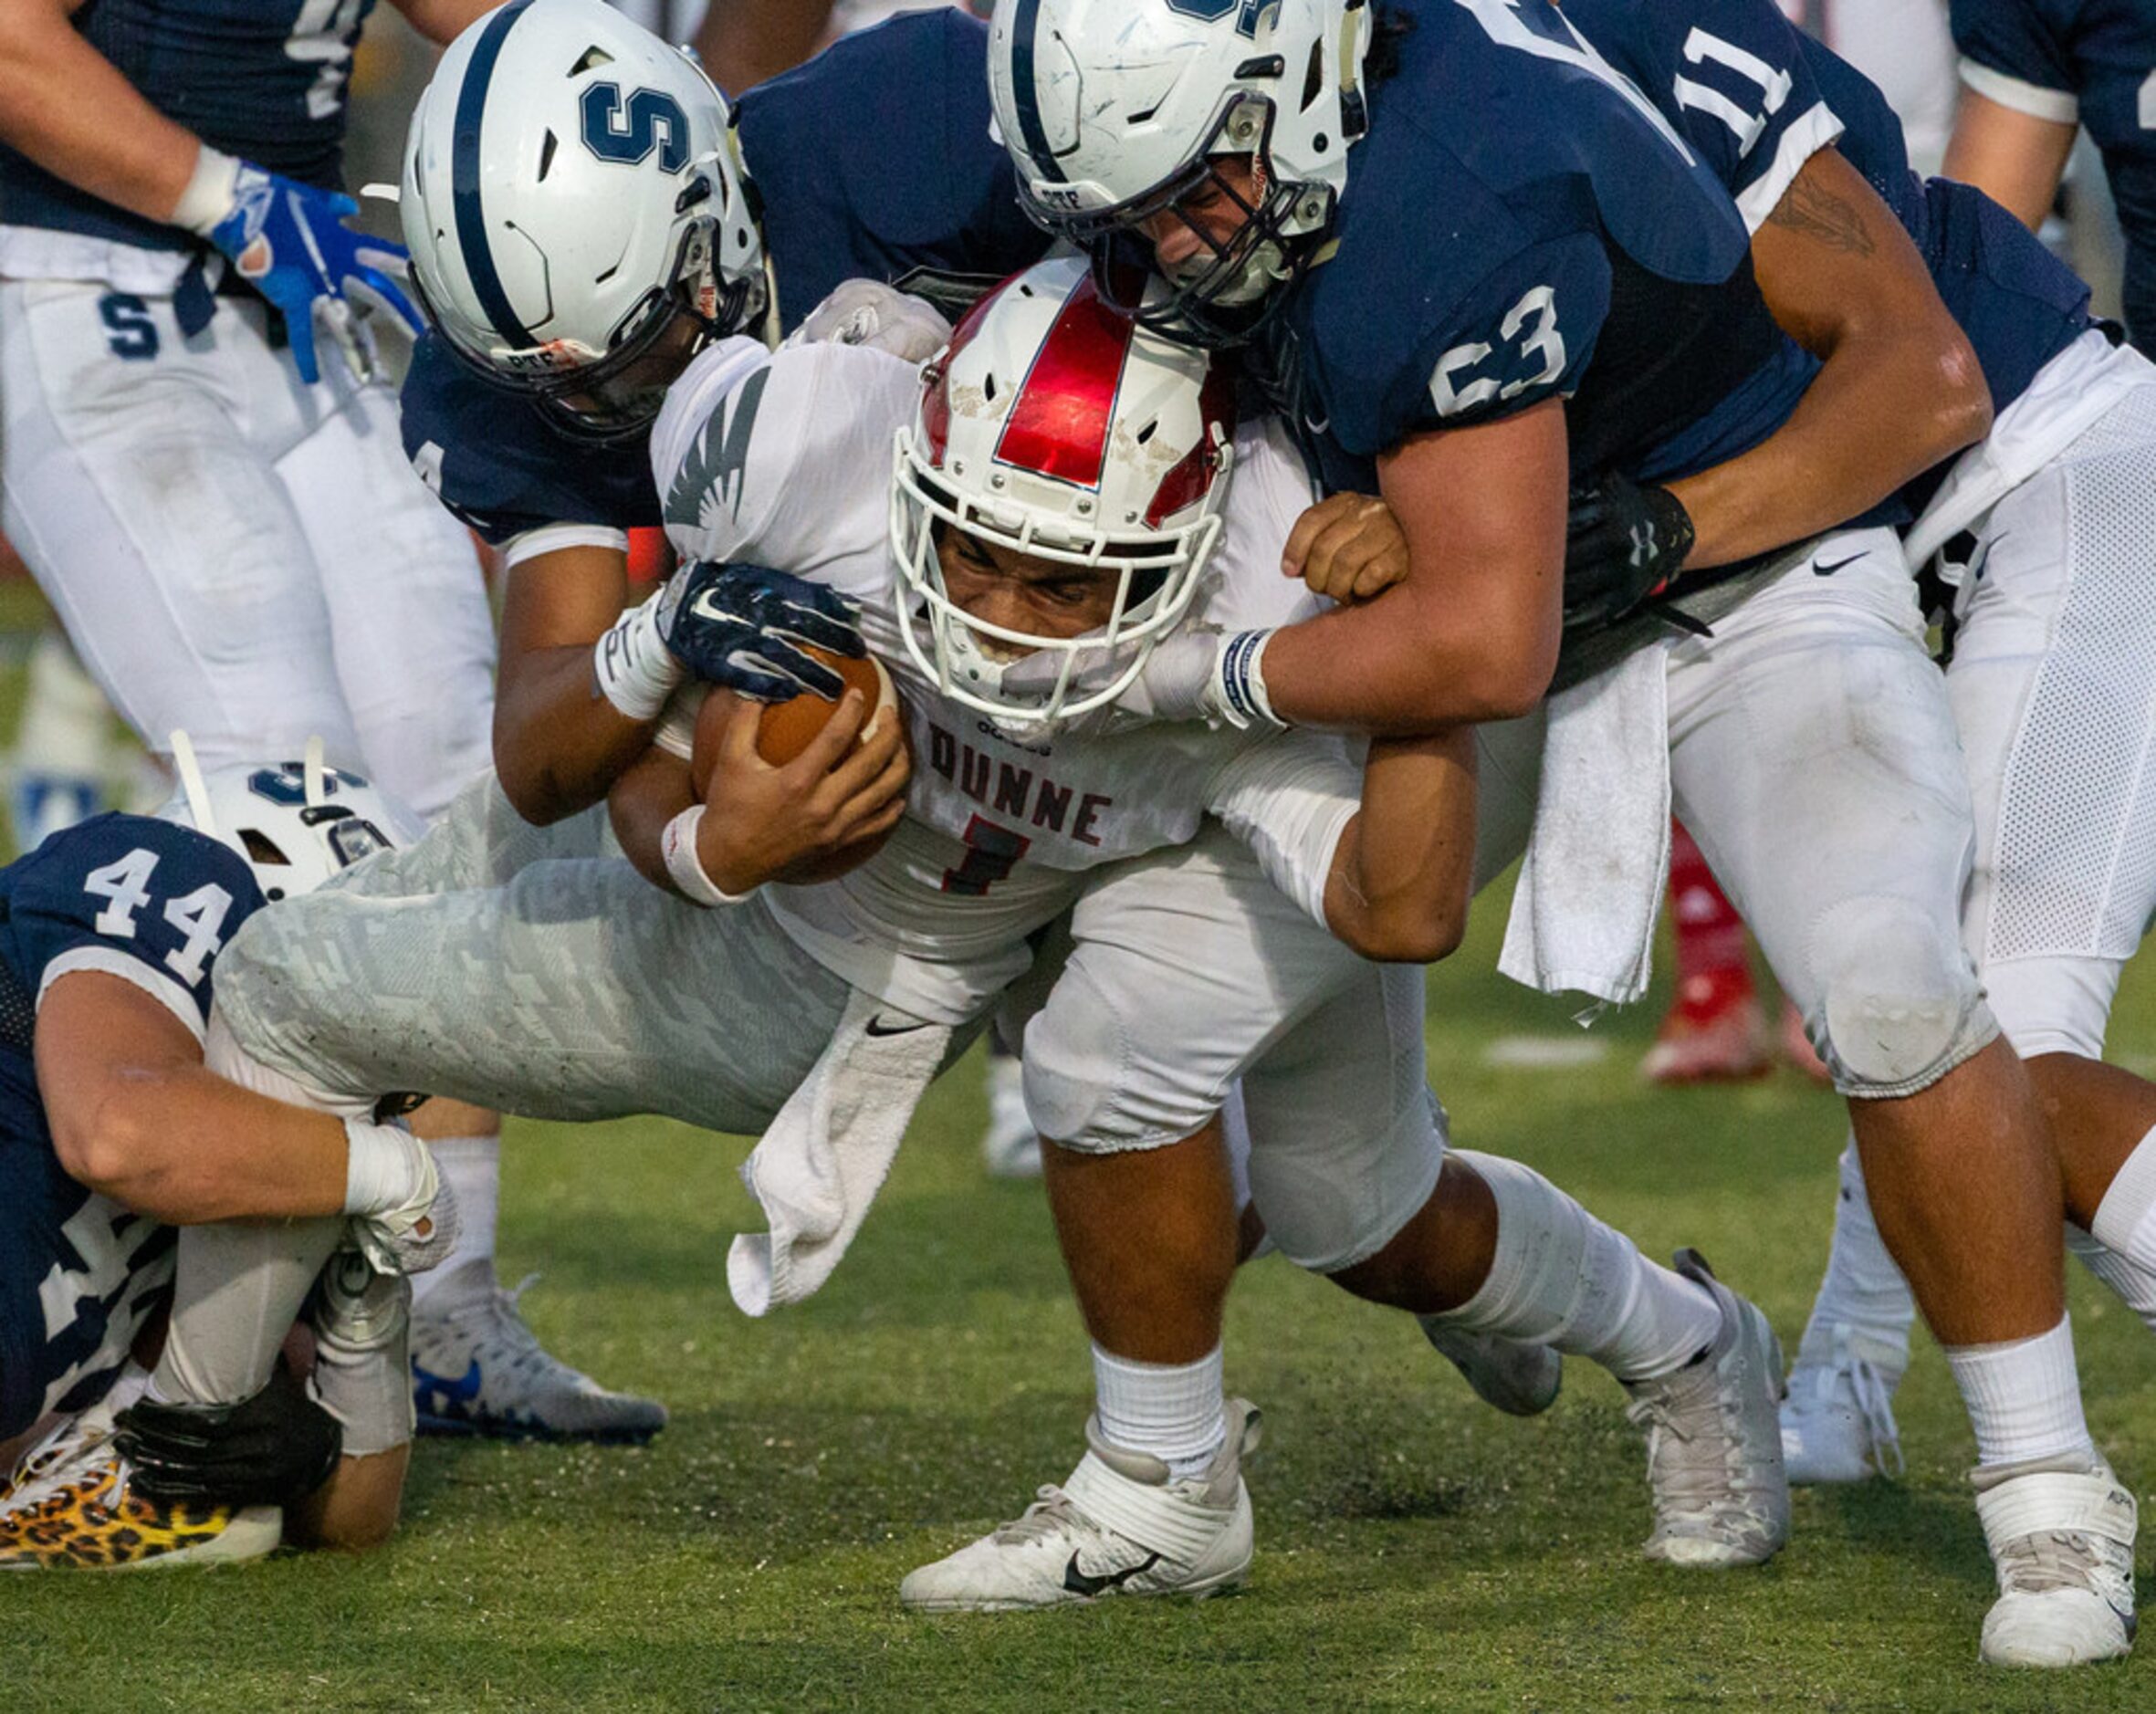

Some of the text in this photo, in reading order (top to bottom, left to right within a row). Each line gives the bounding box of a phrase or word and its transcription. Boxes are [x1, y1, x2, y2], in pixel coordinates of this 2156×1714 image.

[579, 80, 691, 175] S
[1673, 26, 1793, 160] 11
[98, 291, 161, 361] S
[928, 721, 1114, 848] DUNNE
[83, 847, 235, 988] 44
